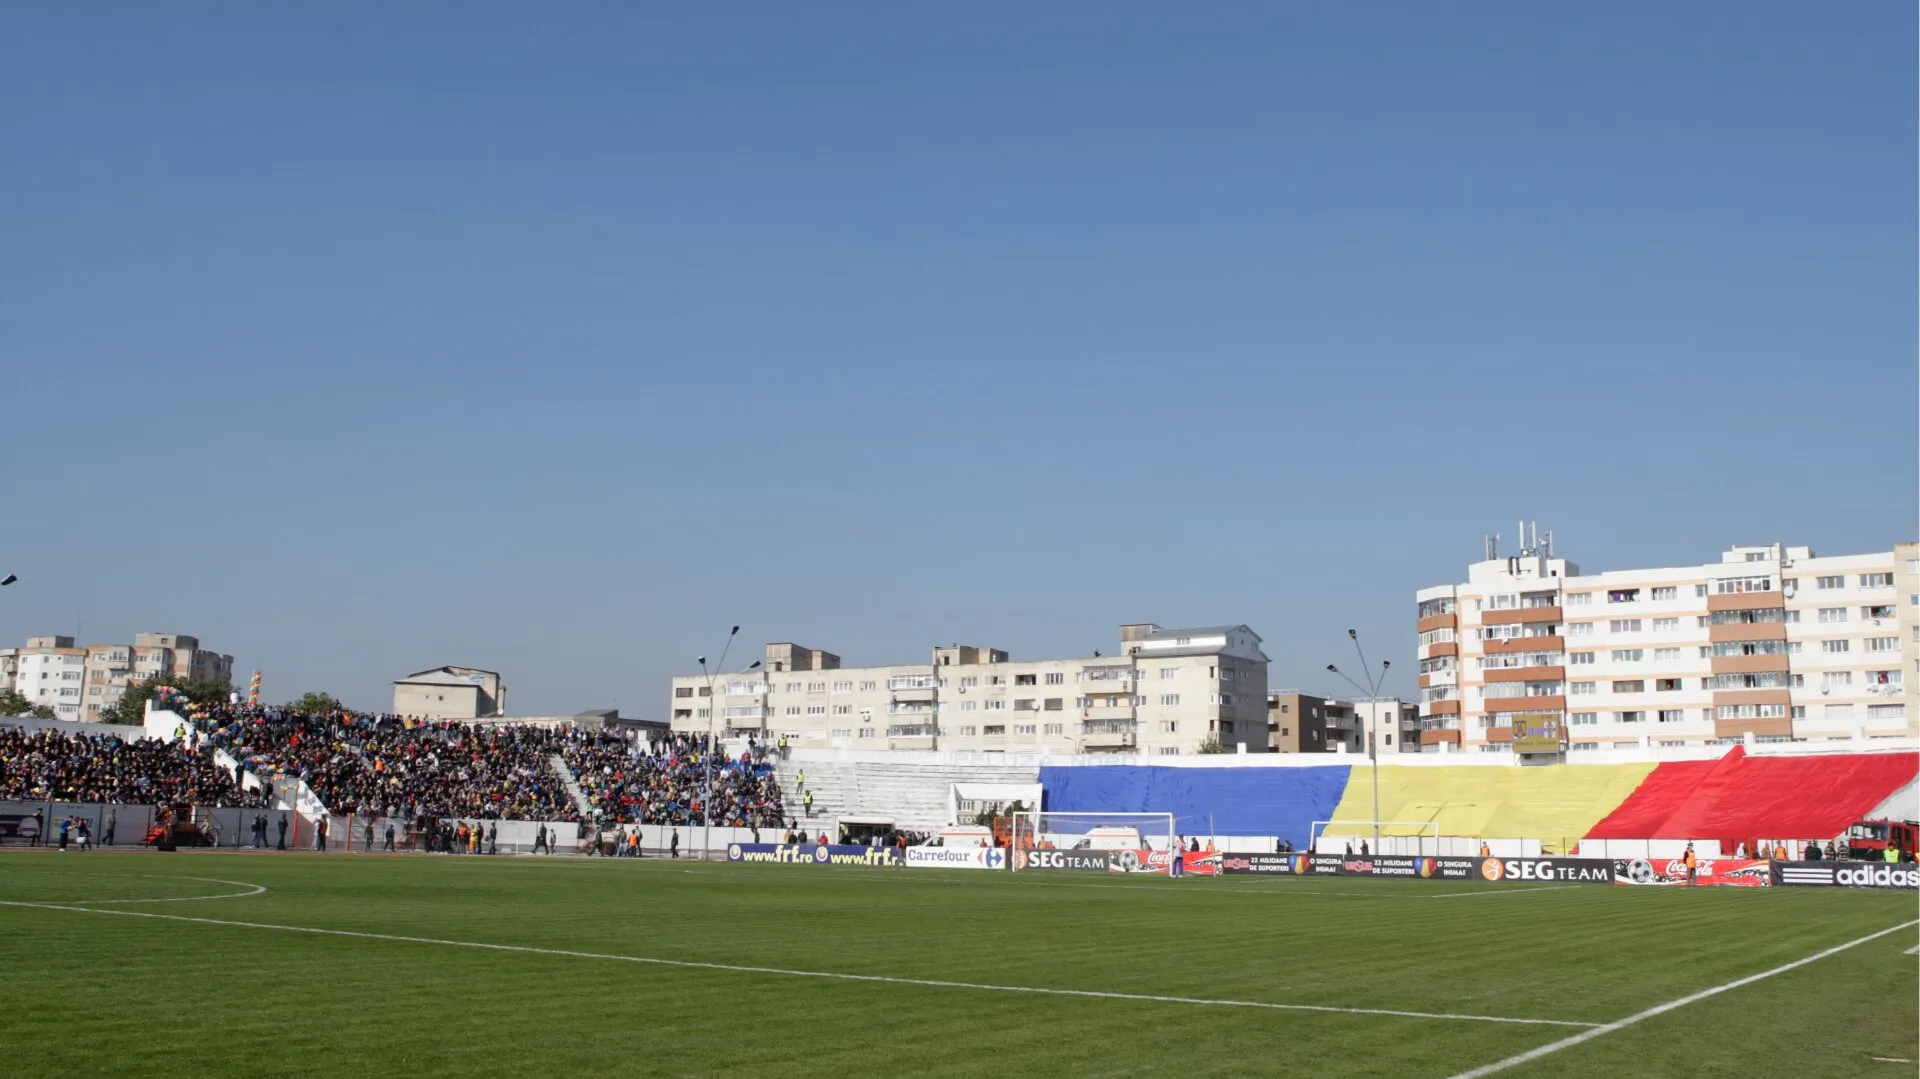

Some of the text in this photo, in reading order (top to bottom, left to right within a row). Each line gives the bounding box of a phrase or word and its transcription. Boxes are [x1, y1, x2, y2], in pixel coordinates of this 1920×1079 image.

[743, 844, 813, 863] www.frf.ro
[831, 846, 903, 866] www.frf.r
[908, 849, 970, 861] Carrefour
[1029, 851, 1104, 868] SEG TEAM
[1505, 860, 1608, 880] SEG TEAM
[1836, 864, 1919, 886] adidas
